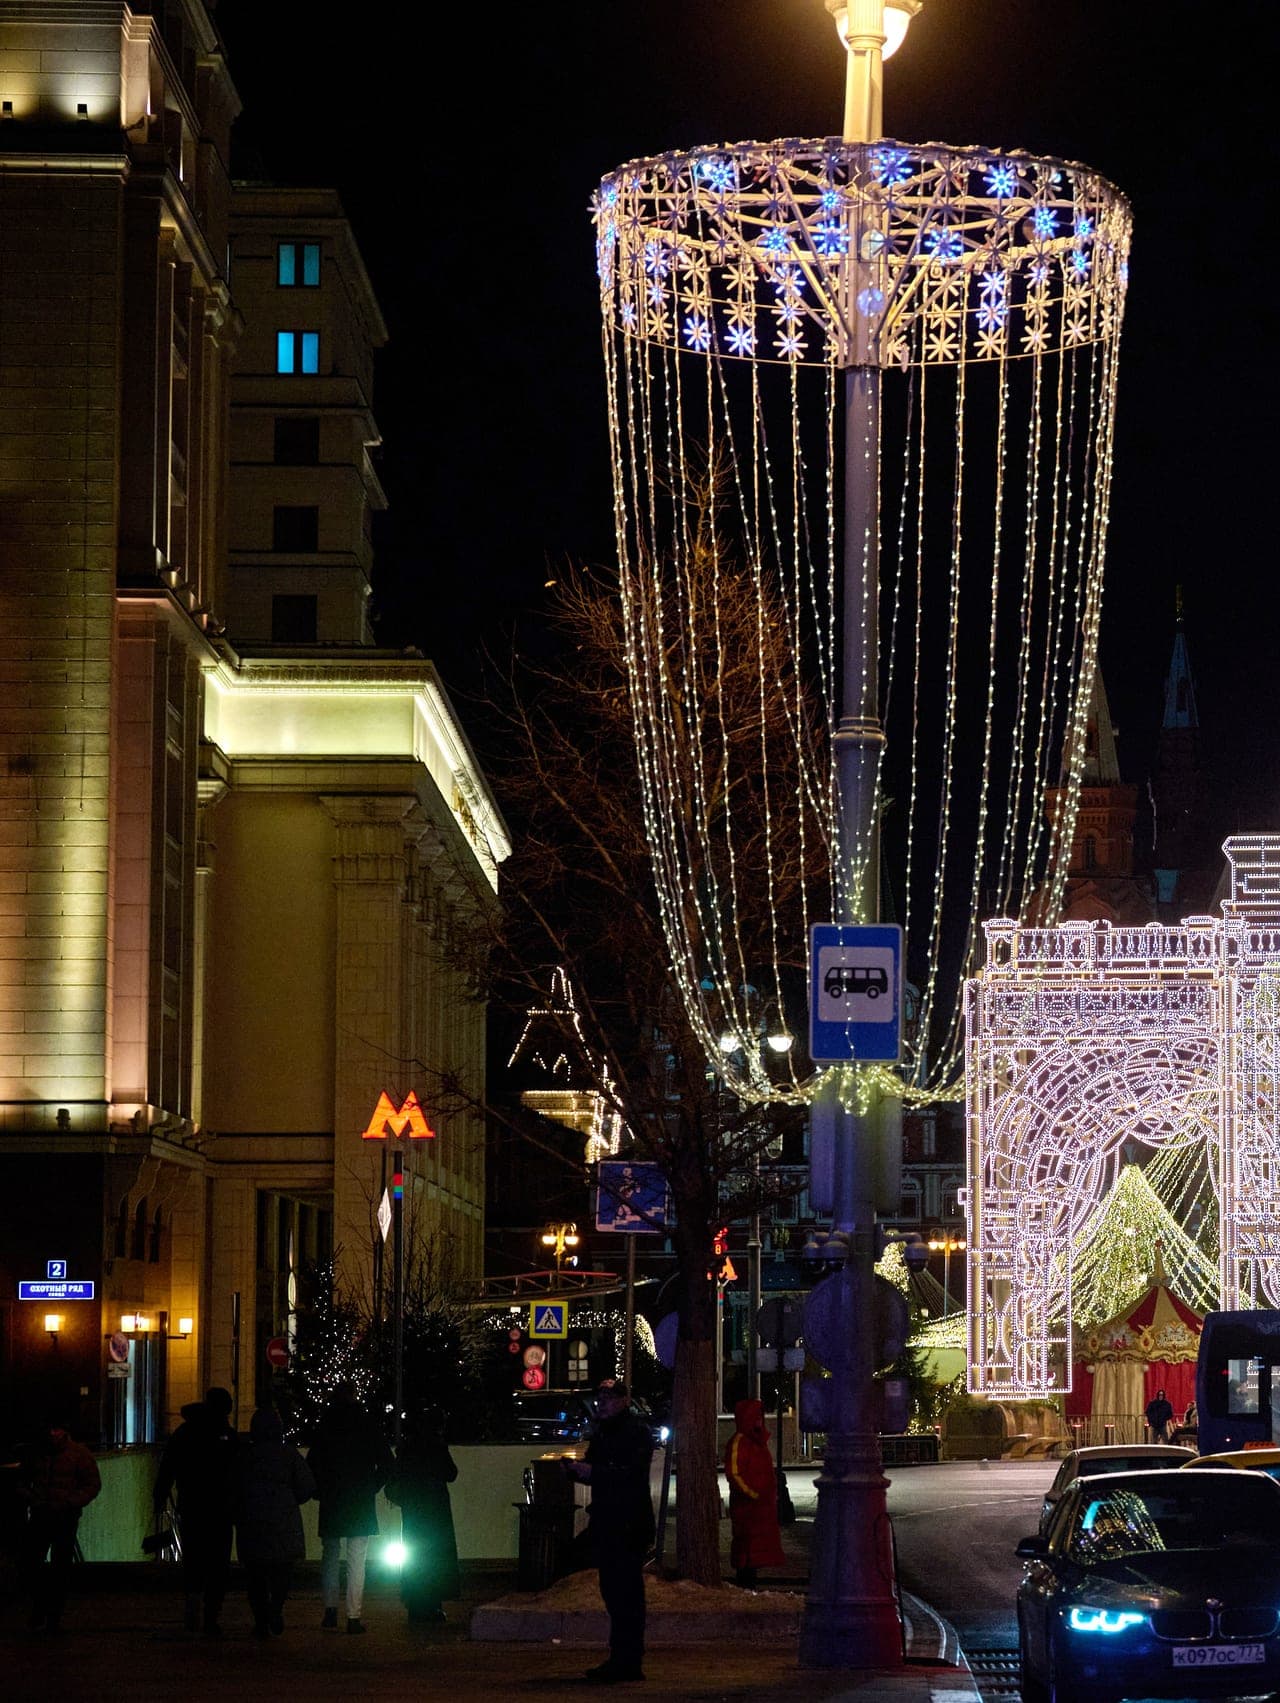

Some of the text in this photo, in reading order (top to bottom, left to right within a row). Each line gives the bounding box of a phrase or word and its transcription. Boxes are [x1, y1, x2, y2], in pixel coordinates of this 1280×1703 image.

[361, 1089, 435, 1138] М
[52, 1263, 62, 1276] 2
[30, 1284, 84, 1293] ОХОТНЫЙ РЯД
